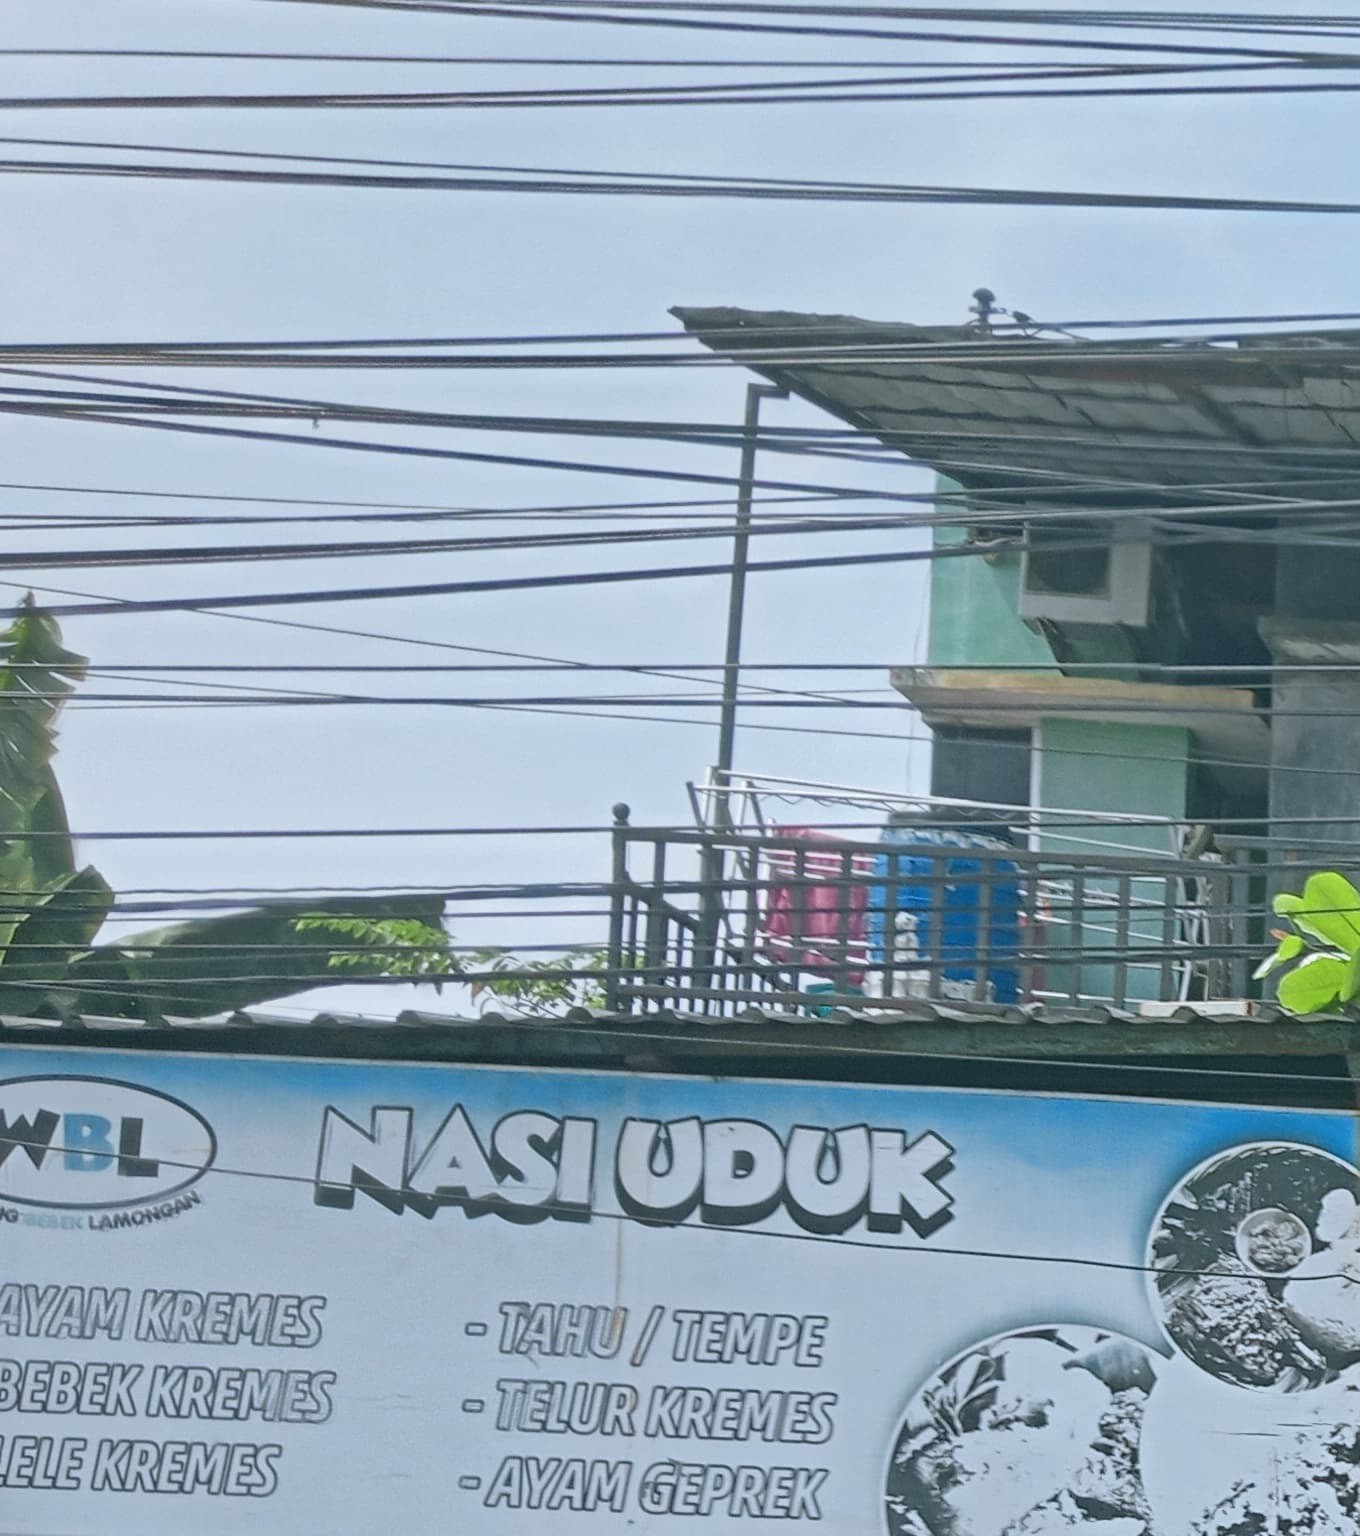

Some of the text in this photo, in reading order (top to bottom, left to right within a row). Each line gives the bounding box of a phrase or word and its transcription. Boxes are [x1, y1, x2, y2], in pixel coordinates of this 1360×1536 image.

[0, 1107, 159, 1178] WBL
[315, 1103, 955, 1239] NASI UDUK
[87, 1189, 202, 1232] LAMONGAN
[0, 1282, 327, 1349] AYAM KREMES
[672, 1309, 829, 1369] TEMPE
[0, 1358, 337, 1424] BEBEK KREMES
[643, 1384, 838, 1445] KREMES
[0, 1433, 282, 1497] ELE KREMES
[637, 1458, 830, 1521] GEPREK
